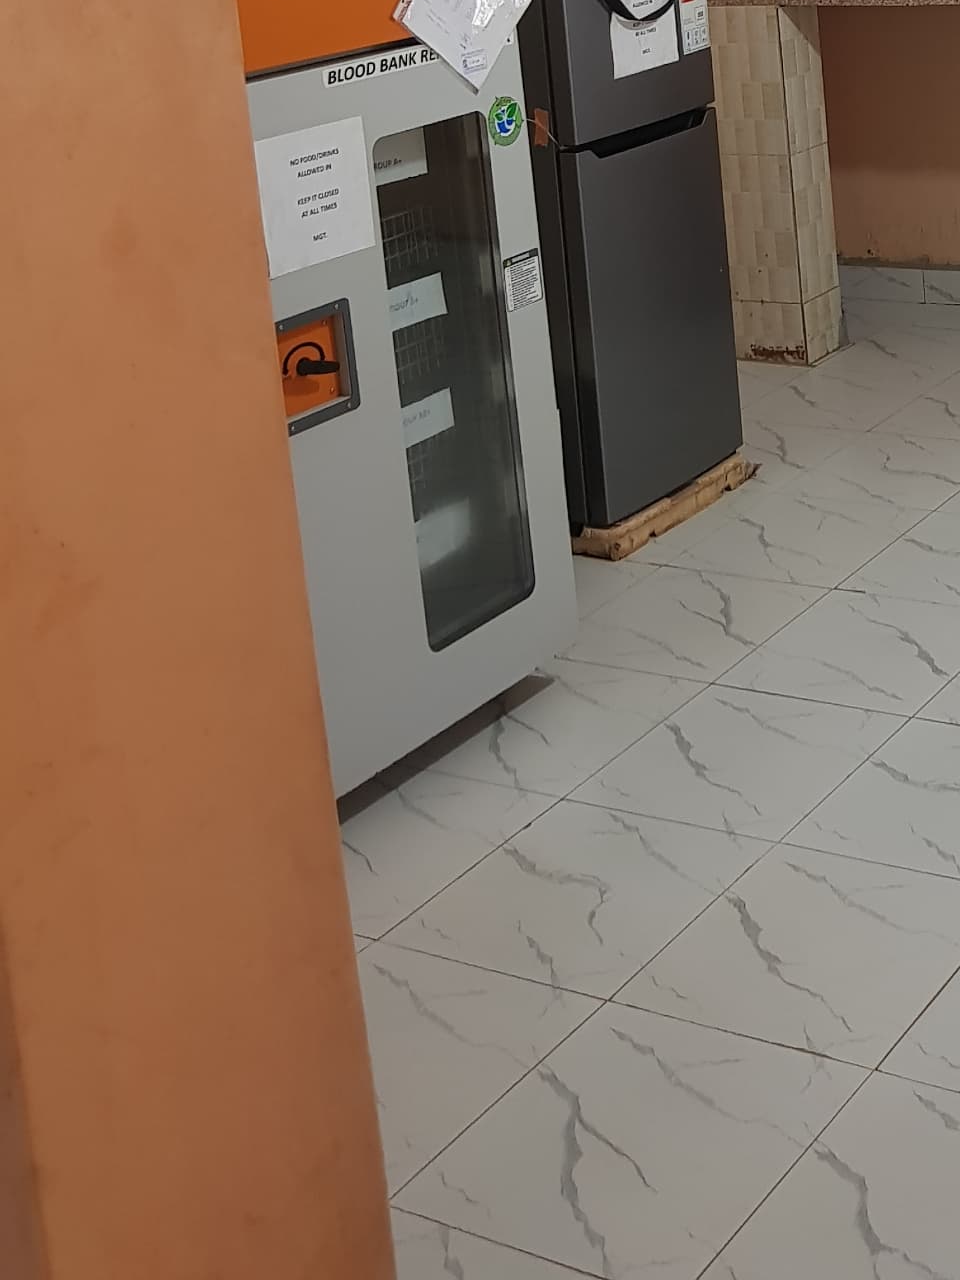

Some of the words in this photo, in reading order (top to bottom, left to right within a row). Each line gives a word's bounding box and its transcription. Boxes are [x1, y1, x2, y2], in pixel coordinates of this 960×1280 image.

[327, 61, 376, 85] BLOOD
[379, 51, 417, 74] BANK
[289, 157, 300, 167] NO
